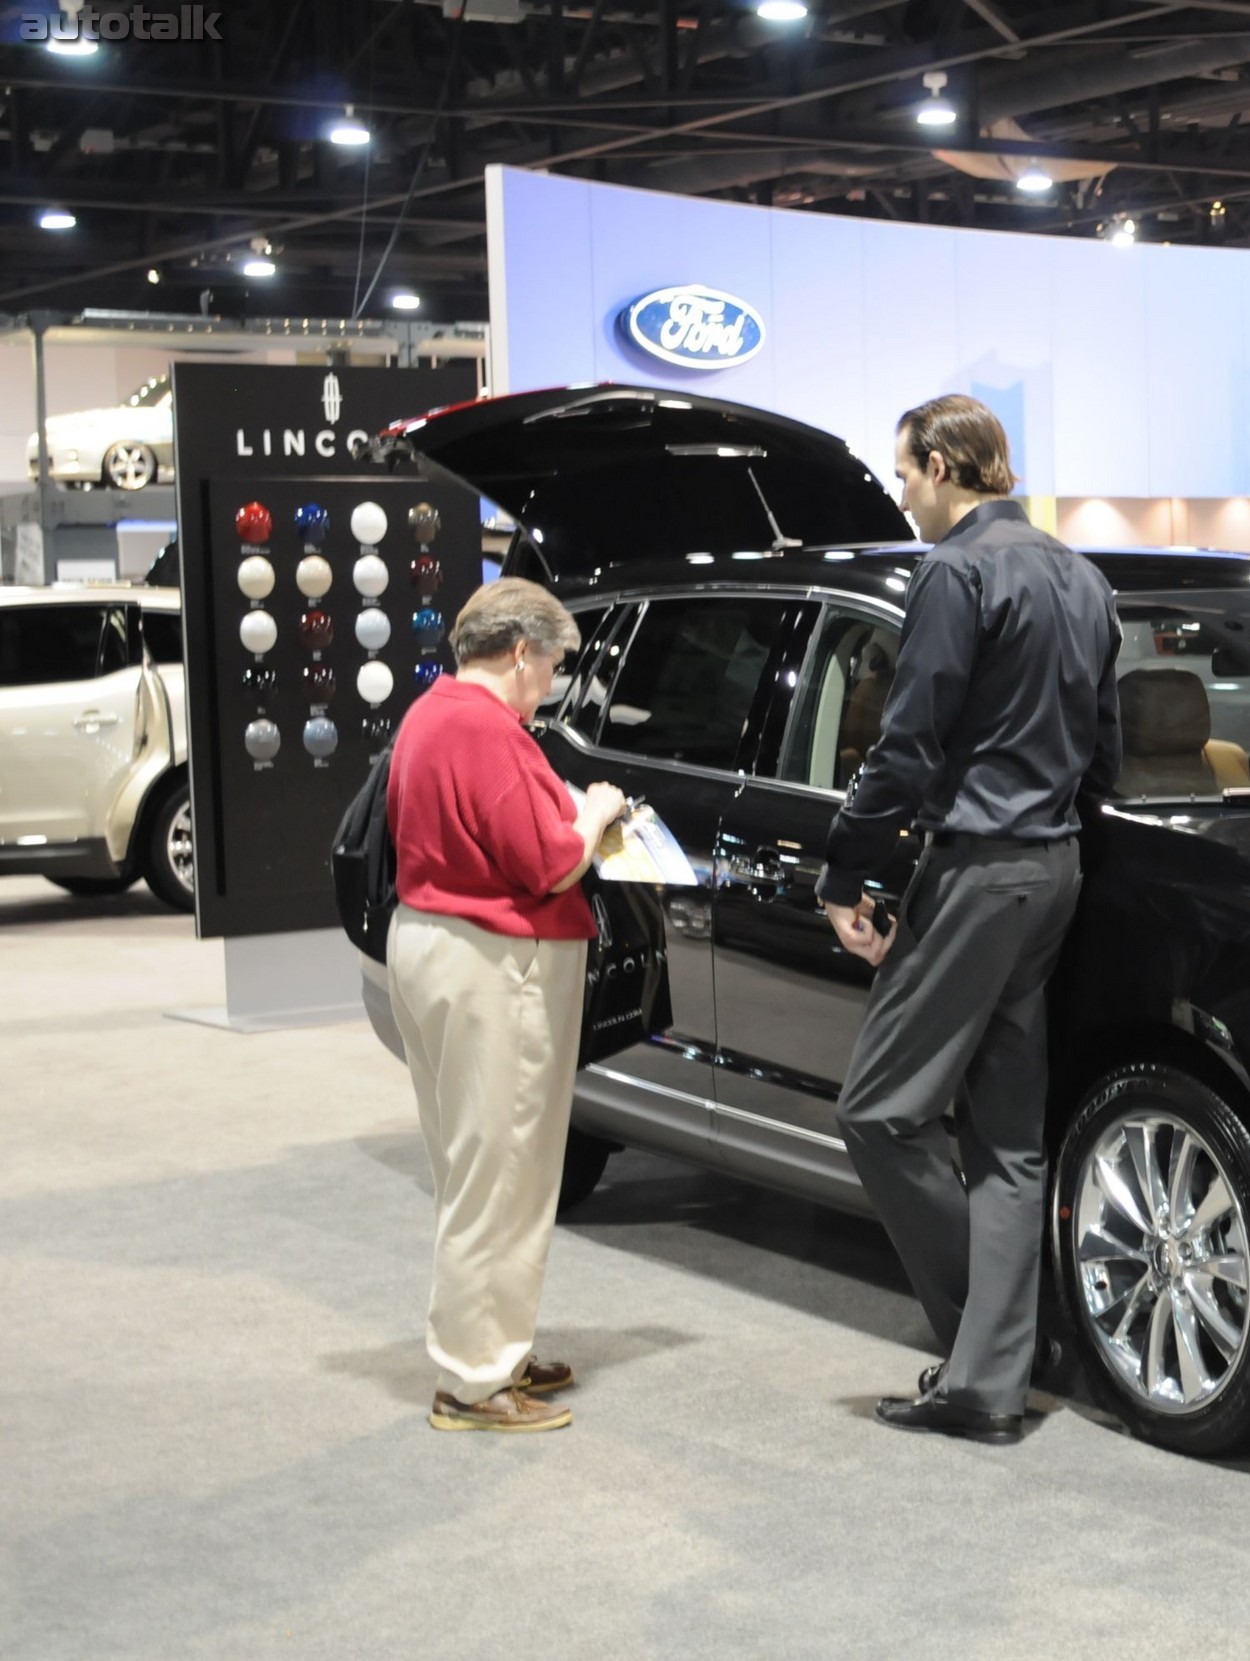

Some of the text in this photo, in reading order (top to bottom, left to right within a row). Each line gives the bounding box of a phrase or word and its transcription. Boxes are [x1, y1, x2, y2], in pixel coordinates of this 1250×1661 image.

[660, 294, 746, 356] Ford
[236, 428, 369, 458] LINCO
[587, 948, 667, 985] NCOLN
